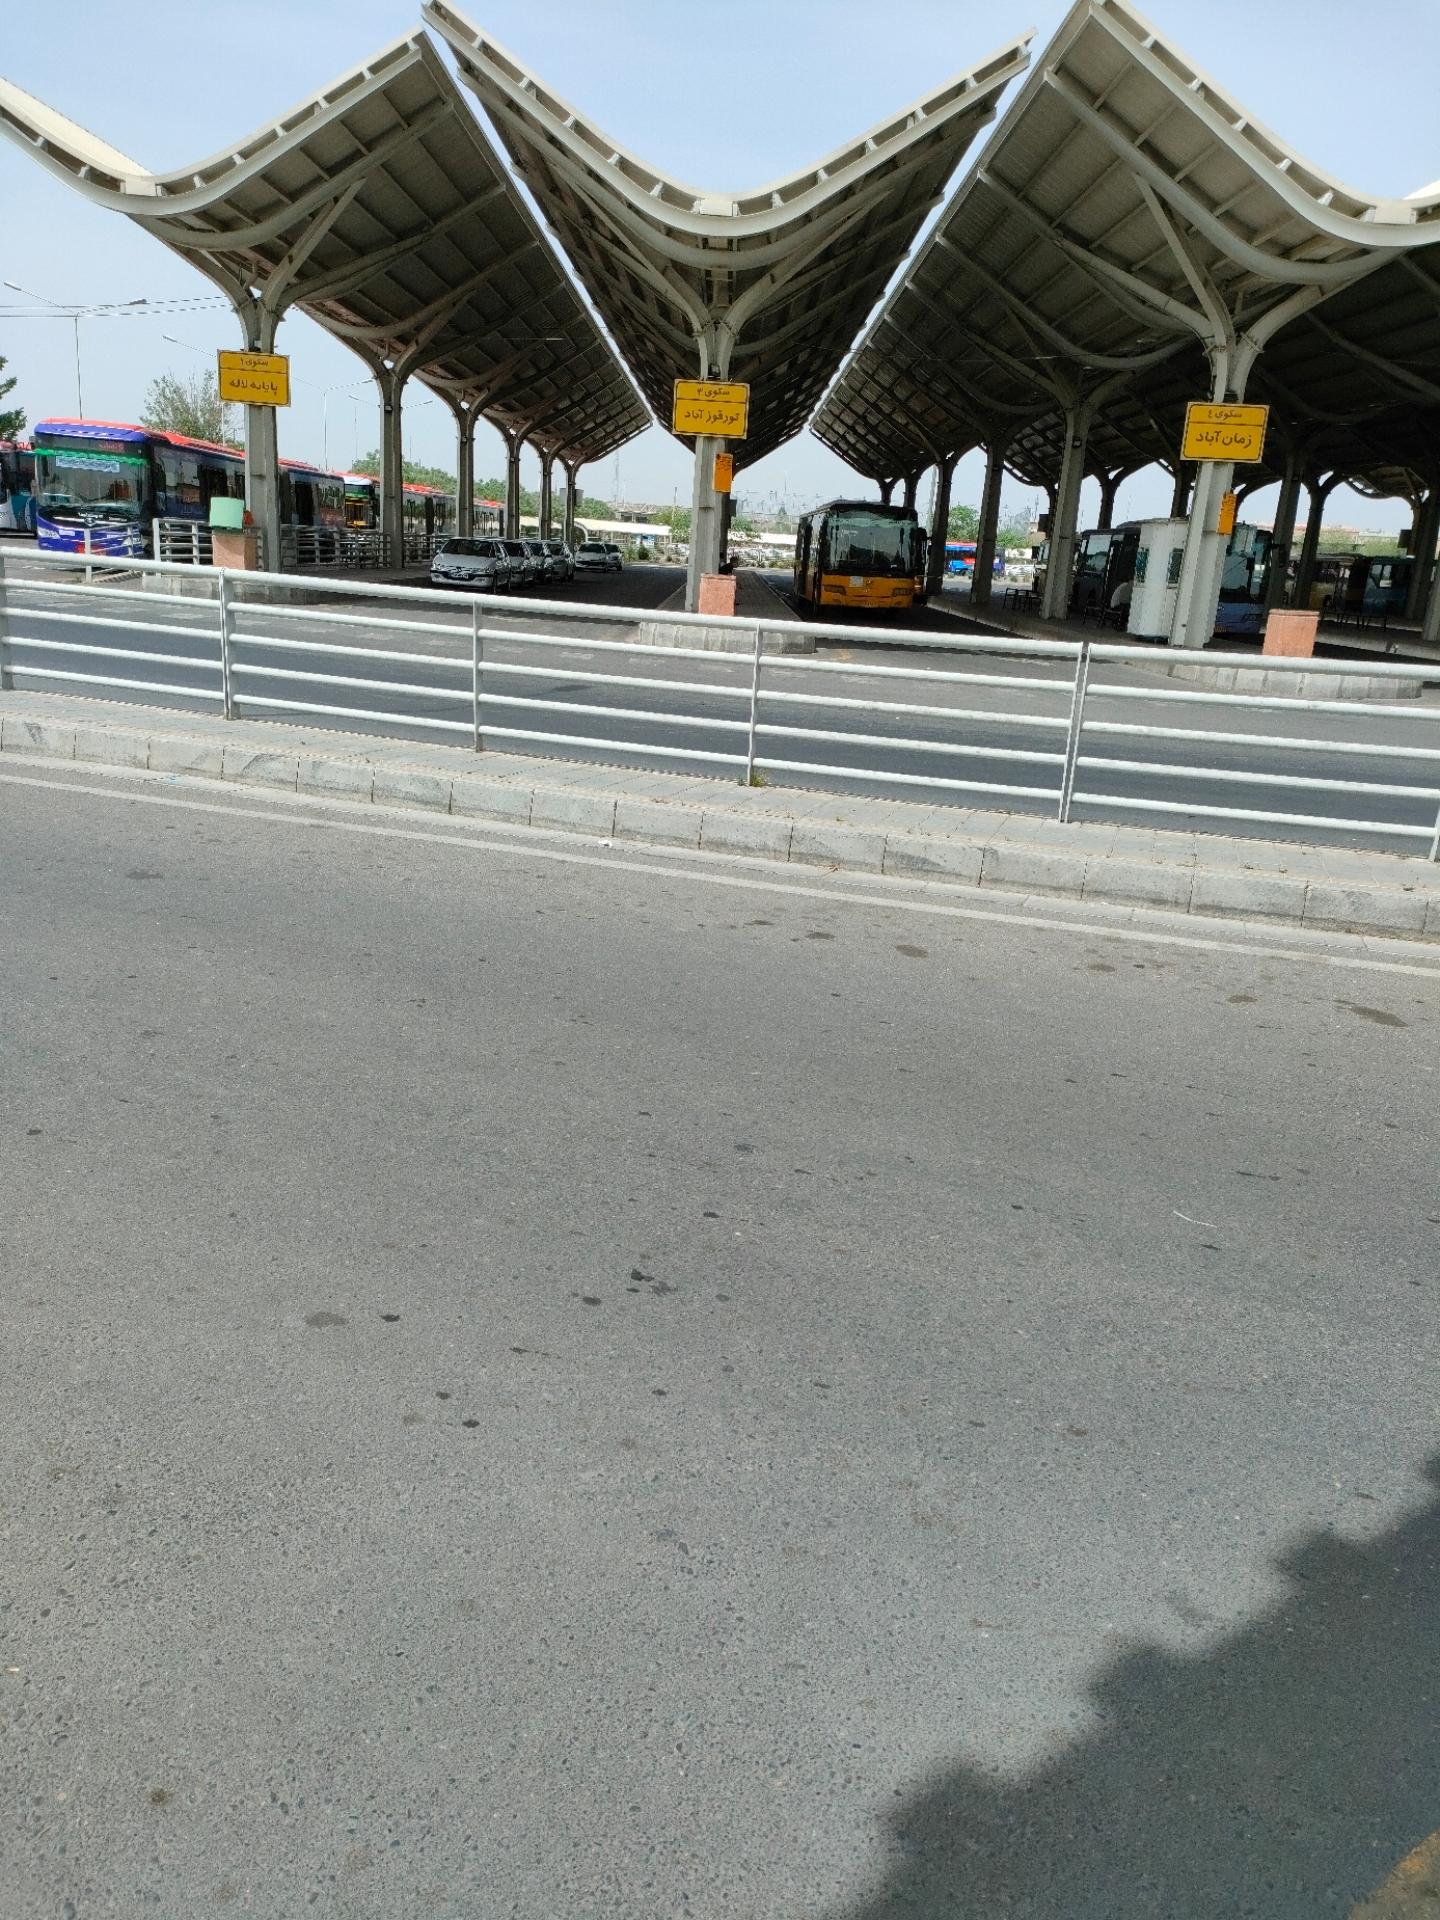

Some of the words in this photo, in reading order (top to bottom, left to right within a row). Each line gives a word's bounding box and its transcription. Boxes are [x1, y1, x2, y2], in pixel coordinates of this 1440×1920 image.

[229, 379, 248, 388] لاله
[704, 388, 730, 398] سکوی
[684, 409, 705, 419] آباد
[1215, 410, 1242, 421] سکوی
[1195, 431, 1223, 446] آباد
[1221, 432, 1252, 449] زمان
